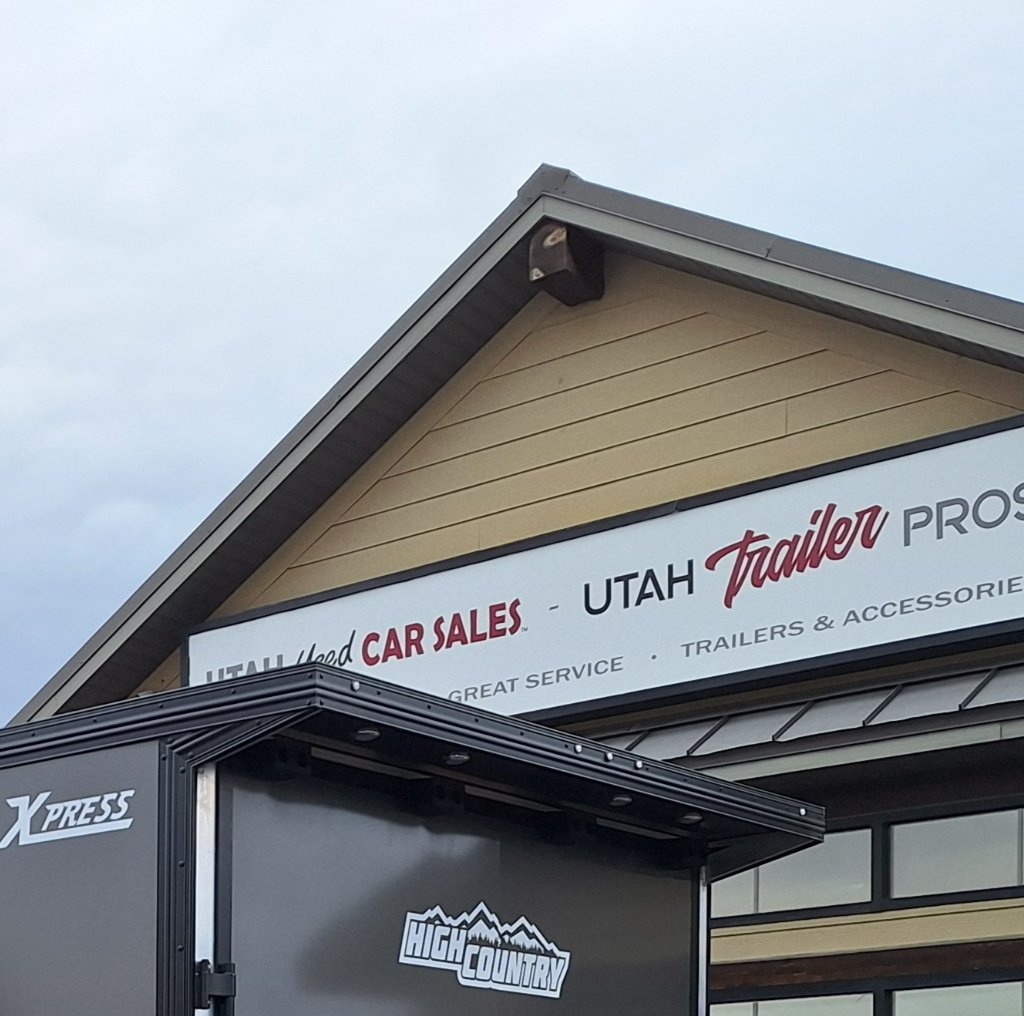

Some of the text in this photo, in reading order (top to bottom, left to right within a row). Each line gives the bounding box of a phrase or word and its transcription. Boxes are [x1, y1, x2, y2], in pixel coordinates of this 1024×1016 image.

[362, 622, 425, 666] CAR
[432, 598, 521, 652] SALES
[584, 559, 694, 615] UTAH
[705, 503, 890, 608] Trailer
[448, 677, 519, 702] GREAT
[525, 656, 624, 689] SERVICE
[681, 620, 804, 658] TRAILERS
[814, 615, 834, 632] &
[405, 920, 565, 991] HIGH COUNTRY
